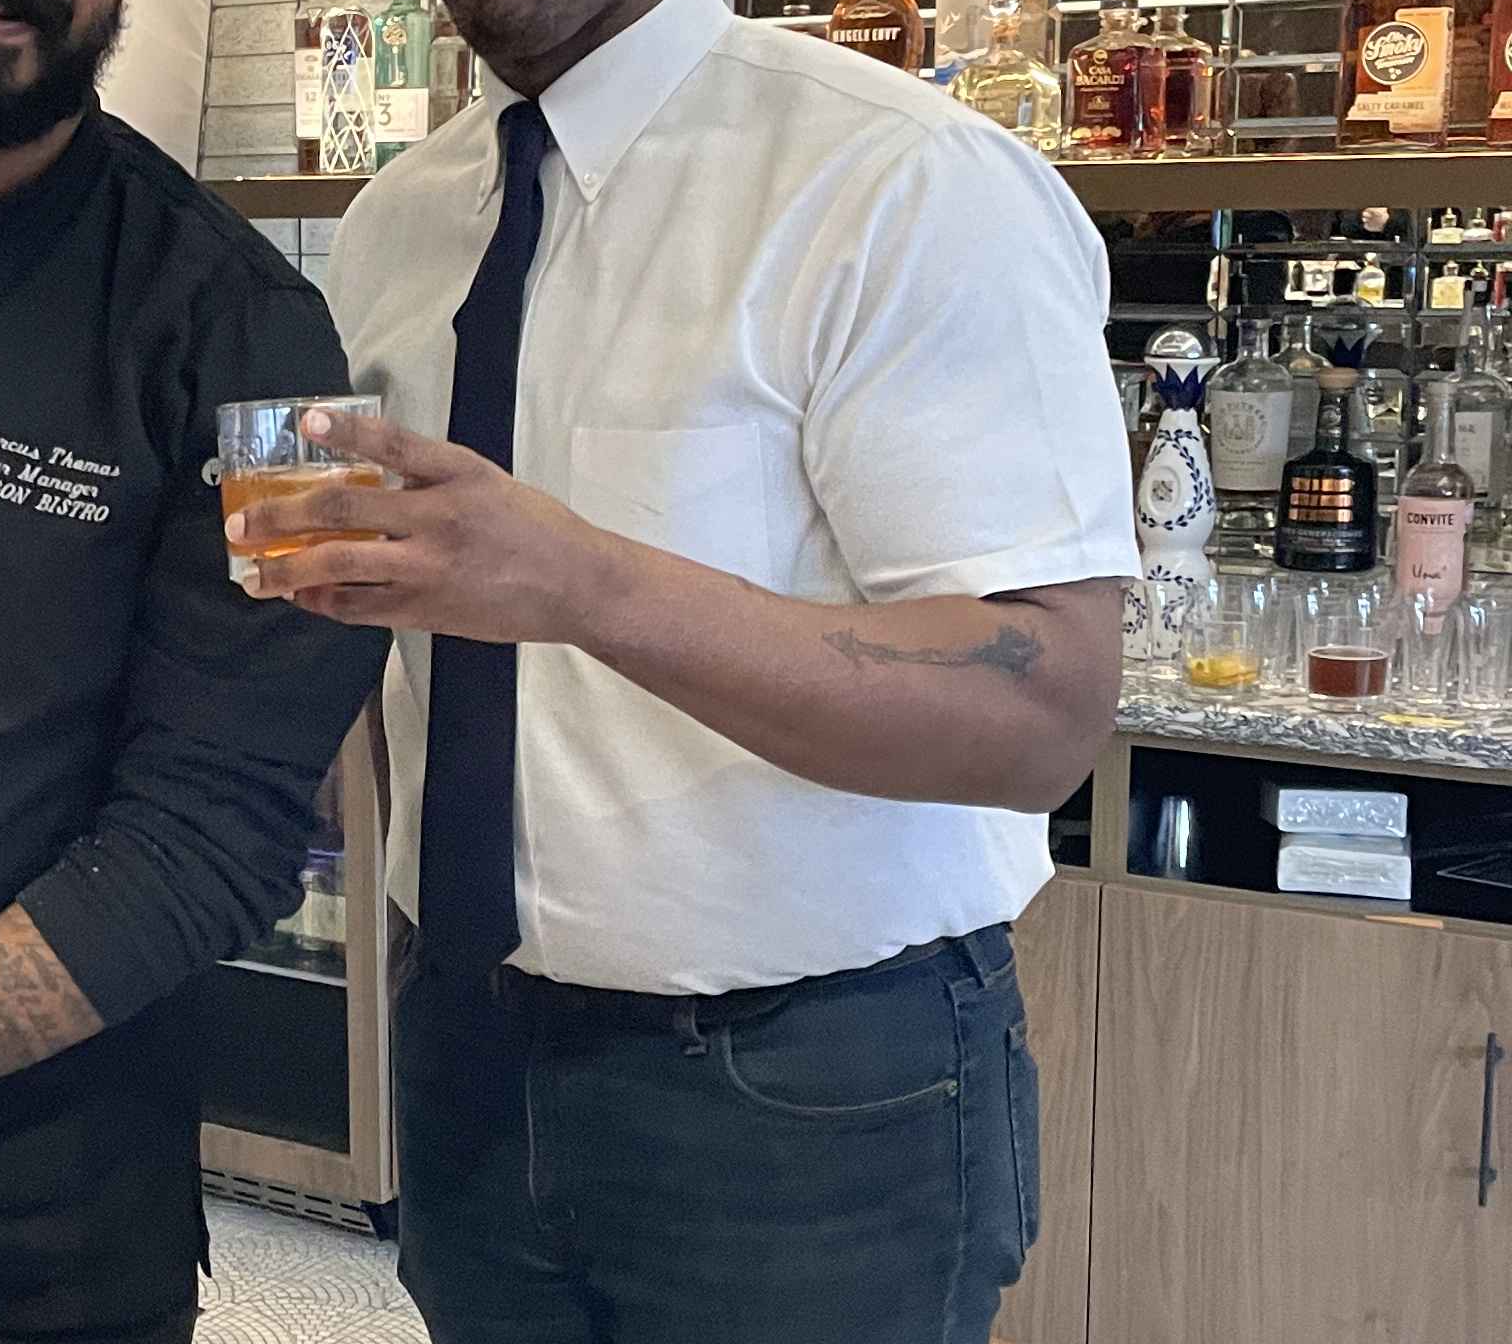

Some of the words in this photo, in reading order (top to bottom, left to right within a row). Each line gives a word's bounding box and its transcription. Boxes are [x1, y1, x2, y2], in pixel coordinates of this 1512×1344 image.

[1075, 74, 1126, 86] BACARDI
[377, 102, 392, 126] 3
[16, 463, 100, 499] Manager
[35, 493, 111, 523] BISTRO
[1406, 511, 1457, 526] CONVITE
